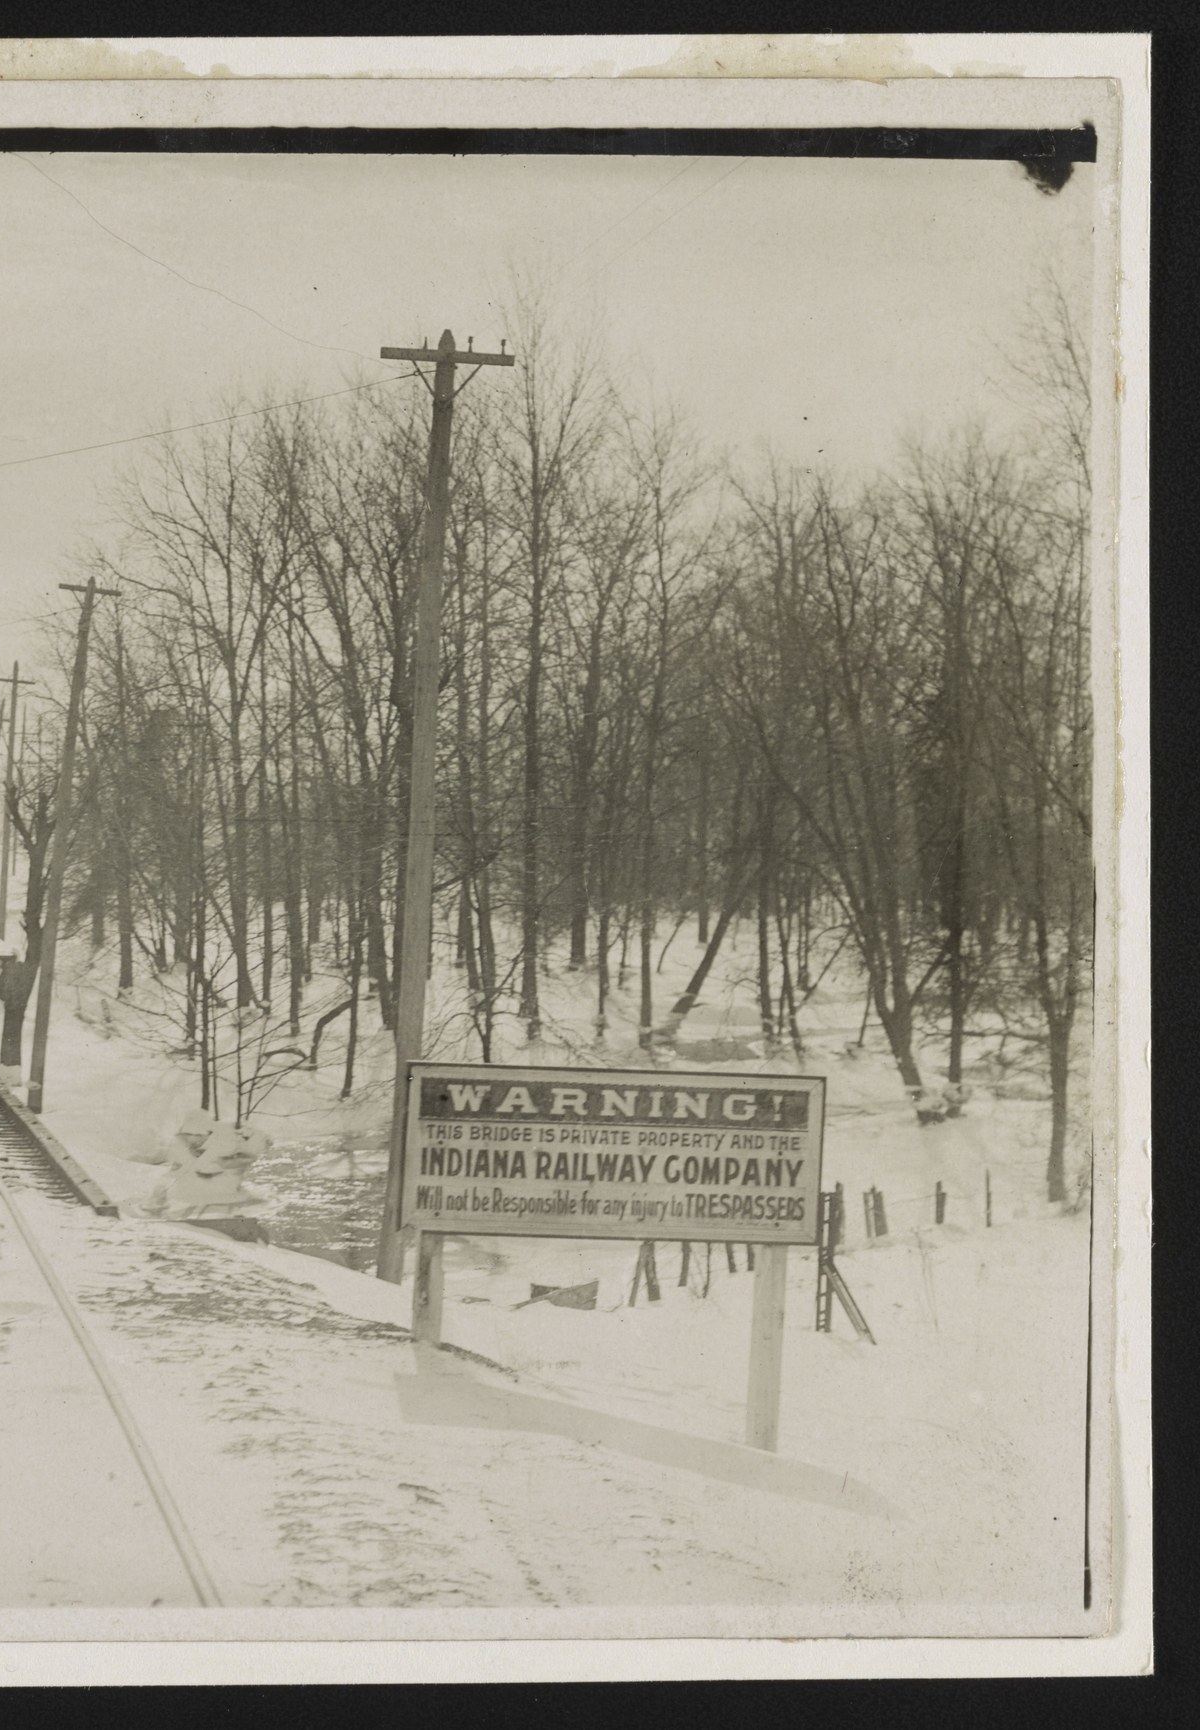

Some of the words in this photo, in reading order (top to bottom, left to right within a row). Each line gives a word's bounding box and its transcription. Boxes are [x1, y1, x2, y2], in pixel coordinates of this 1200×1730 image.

[446, 1084, 784, 1121] WARNING!
[426, 1123, 464, 1141] THIS
[469, 1125, 533, 1143] BRIDGE
[538, 1127, 556, 1142] IS
[560, 1128, 631, 1146] PRIVATE
[638, 1131, 726, 1151] PROPERTY
[730, 1134, 765, 1150] AND
[770, 1135, 802, 1152] THE
[421, 1147, 527, 1179] INDIANA
[535, 1151, 657, 1183] RAILWAY
[664, 1154, 804, 1187] COMPANY
[417, 1185, 443, 1211] Will
[447, 1188, 469, 1212] not
[472, 1187, 490, 1213] be
[492, 1187, 578, 1217] Responsible
[580, 1190, 601, 1217] for
[604, 1194, 628, 1221] any
[631, 1193, 669, 1222] injury
[670, 1196, 684, 1218] to
[685, 1193, 805, 1221] TRESPASSERS
